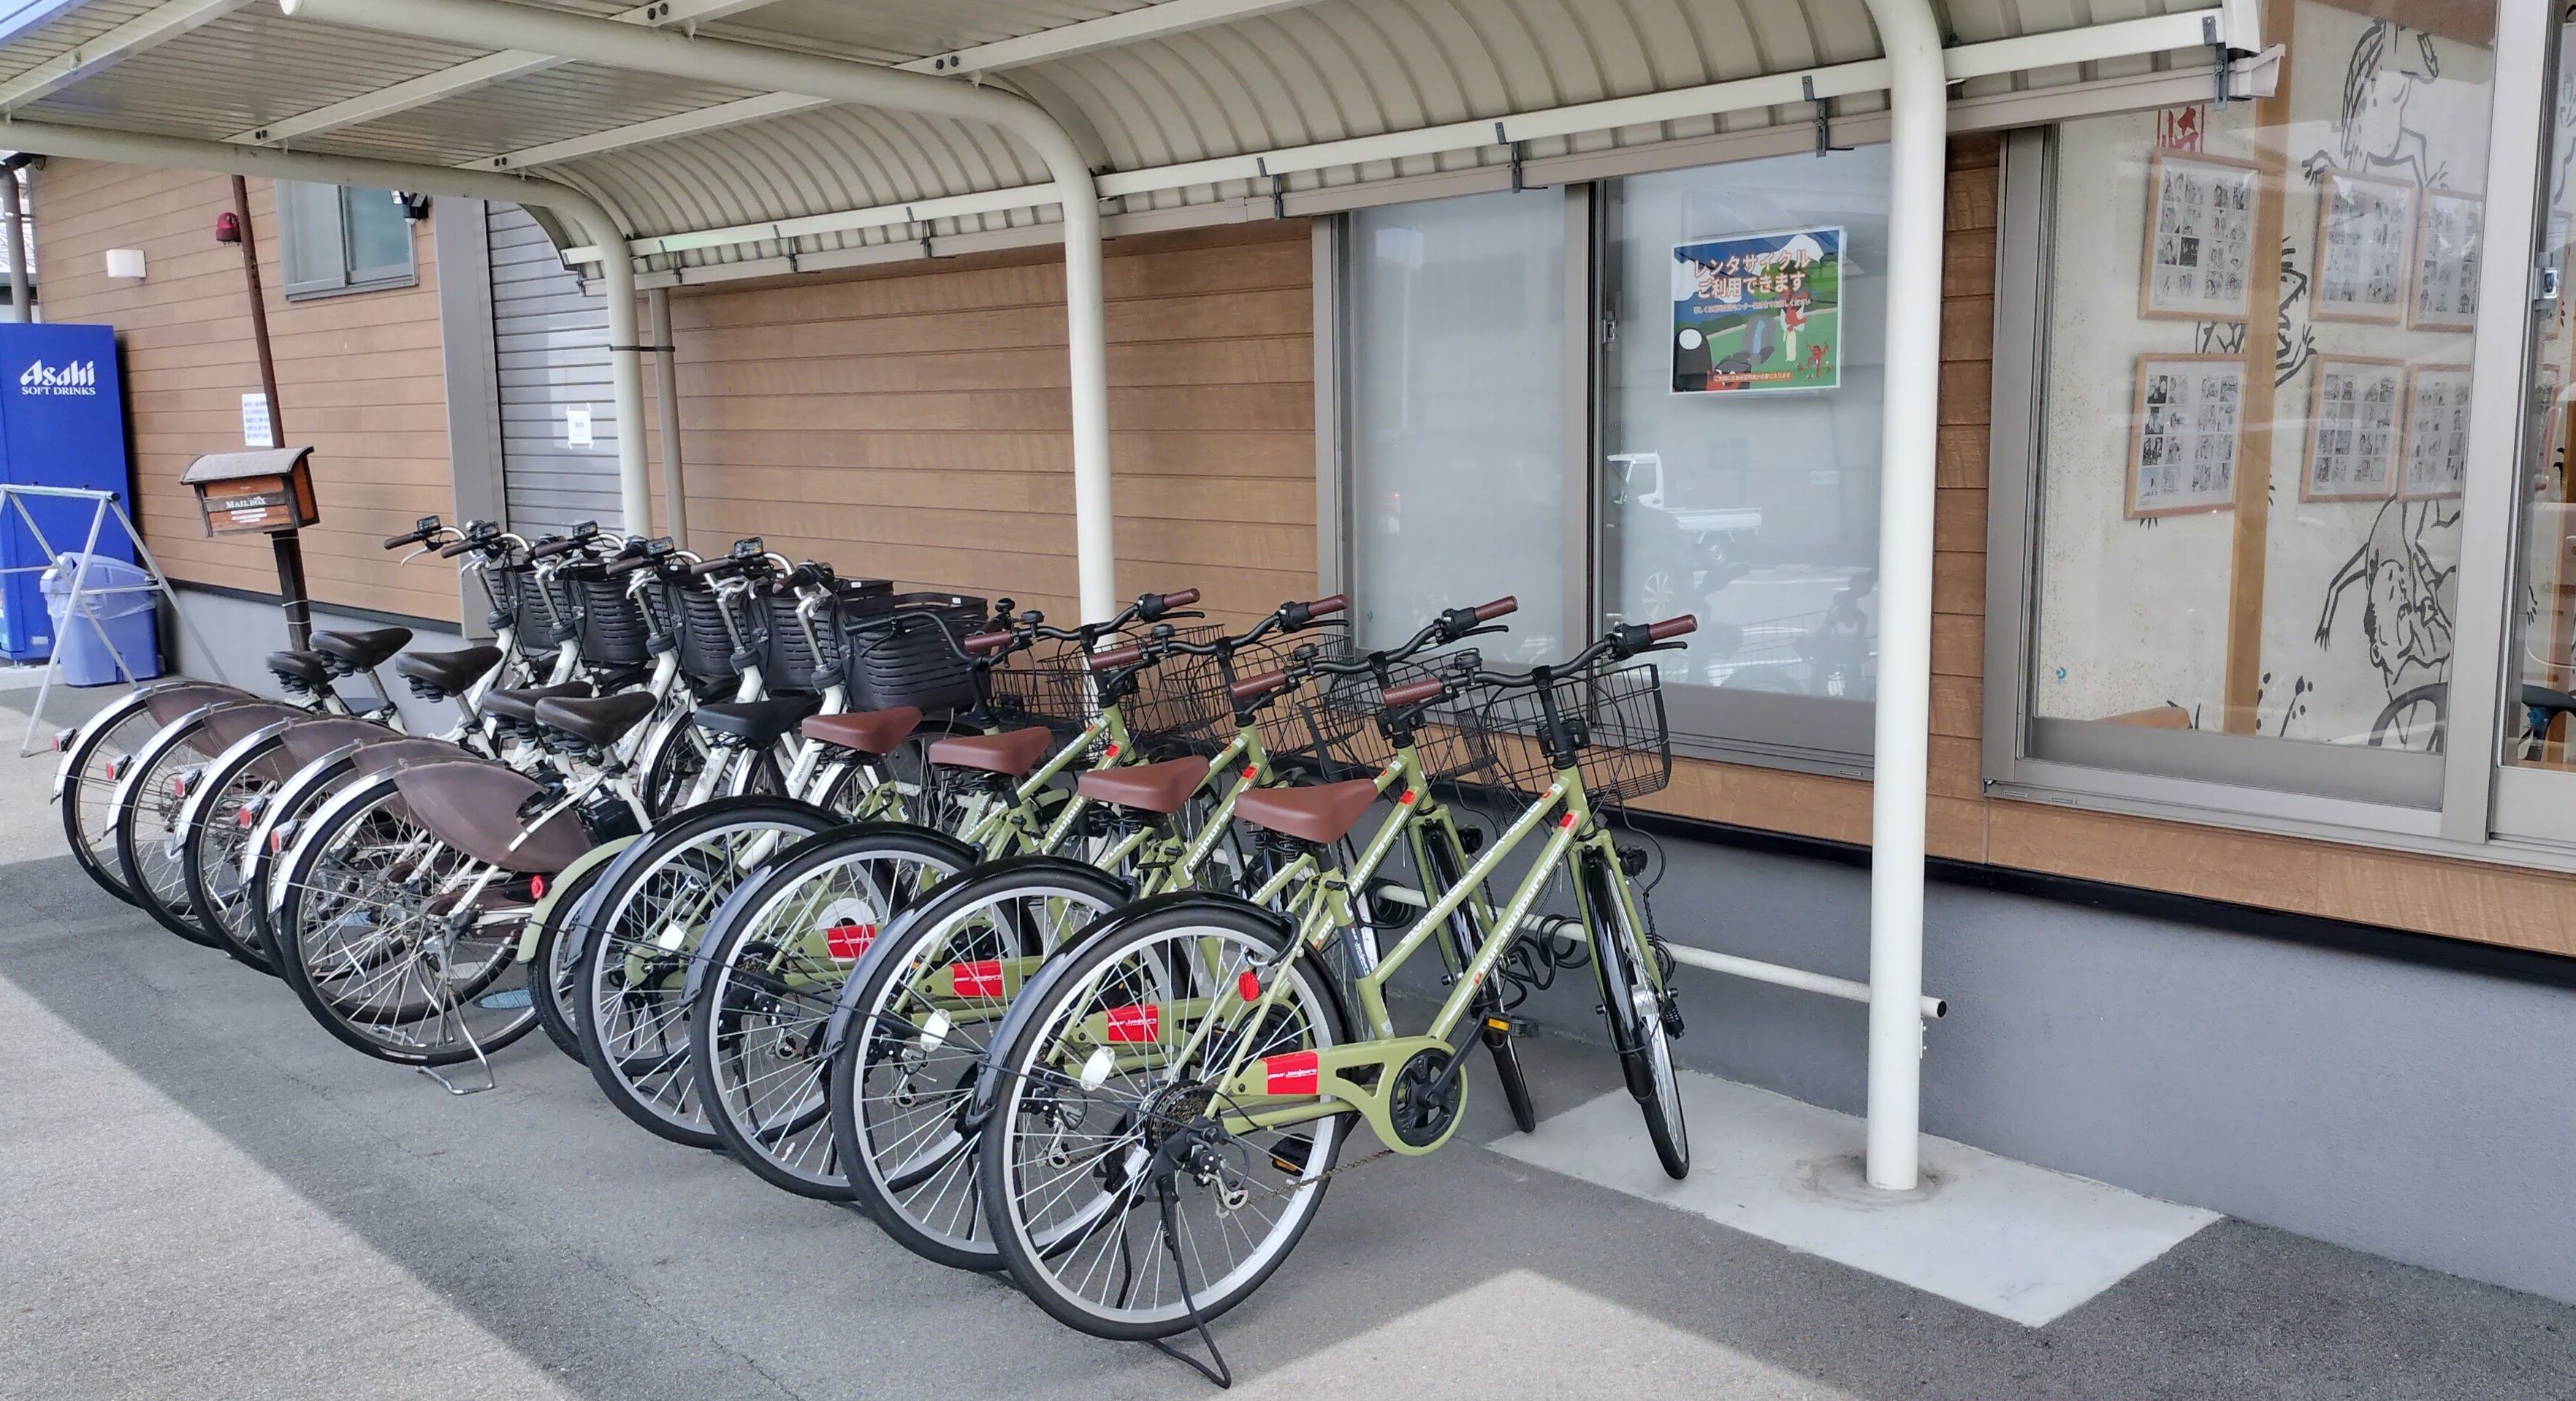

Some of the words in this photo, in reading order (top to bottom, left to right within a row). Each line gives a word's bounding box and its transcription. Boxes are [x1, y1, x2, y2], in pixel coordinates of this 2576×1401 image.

[1694, 249, 1810, 278] レンタサイクル
[1698, 270, 1806, 298] ご利用できます
[20, 359, 95, 386] Asahi
[21, 387, 51, 395] SOFT
[53, 387, 96, 395] DRINKS
[226, 500, 249, 509] MAIL
[249, 497, 267, 506] BOX
[793, 752, 812, 783] Panasonic
